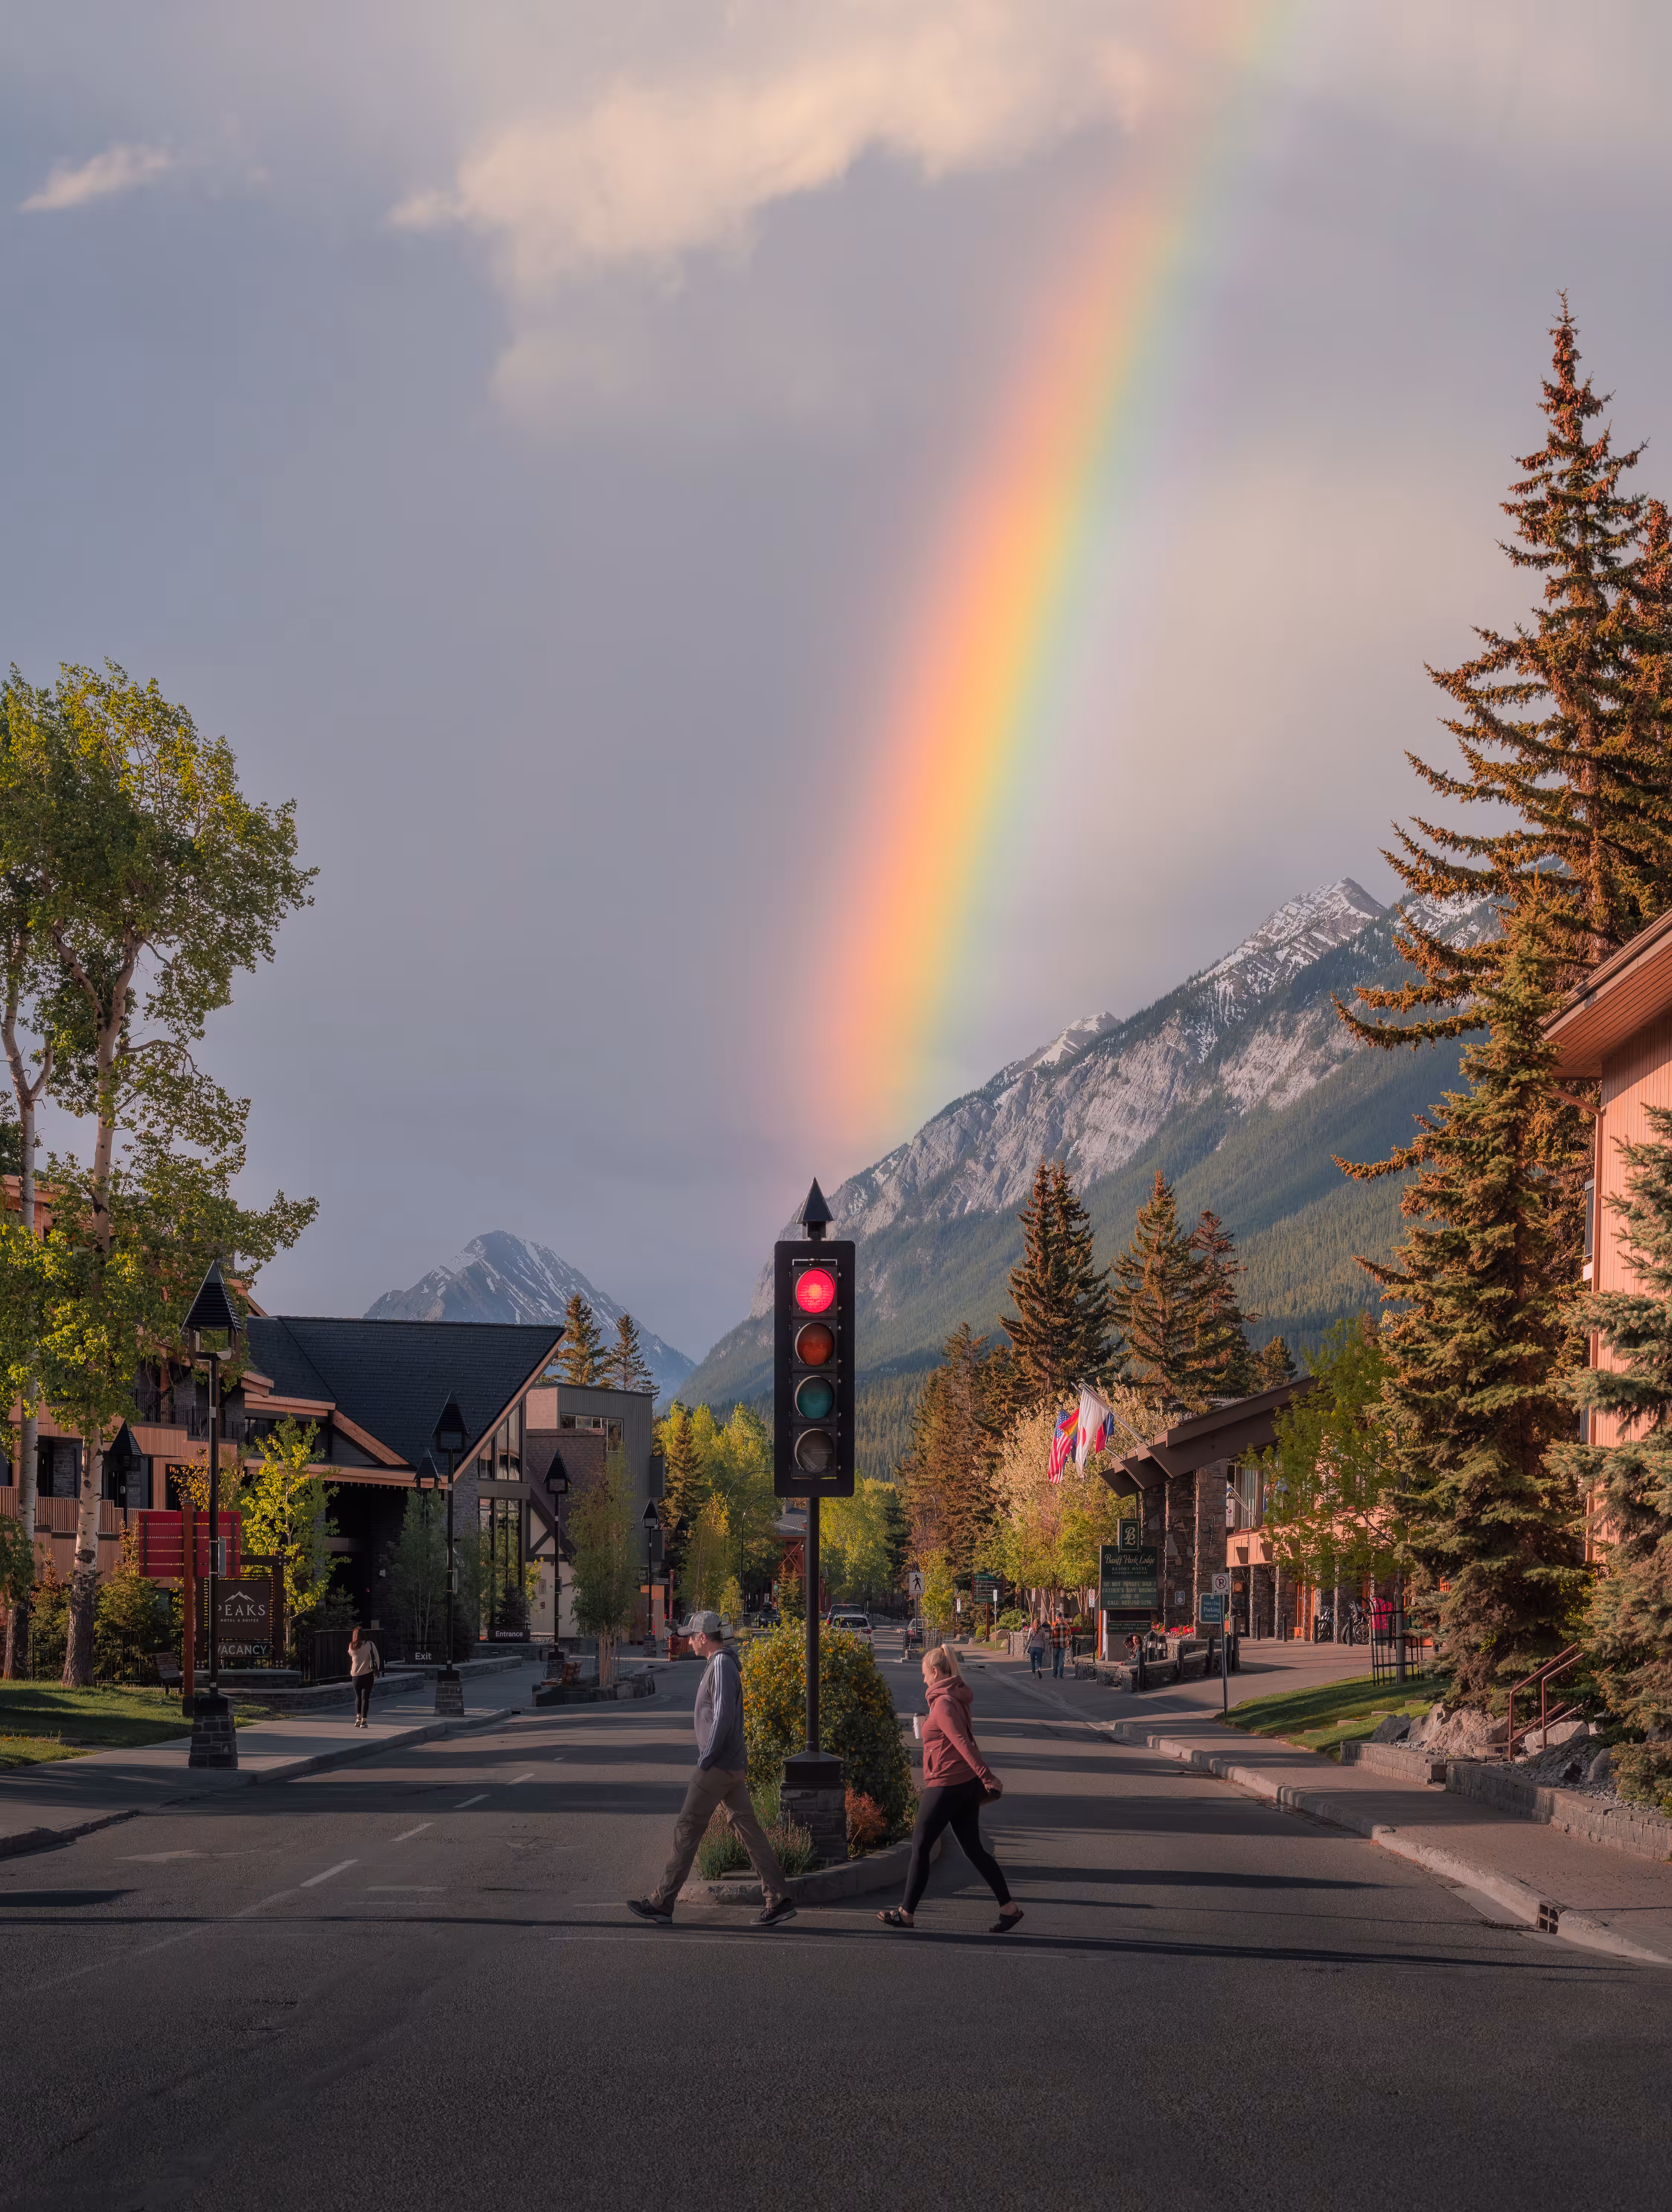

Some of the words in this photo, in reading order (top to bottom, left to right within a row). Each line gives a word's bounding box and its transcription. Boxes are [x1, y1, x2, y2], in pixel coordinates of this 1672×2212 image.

[1105, 1554, 1124, 1565] Banff
[1124, 1554, 1139, 1565] Park
[1139, 1554, 1155, 1566] Lodge
